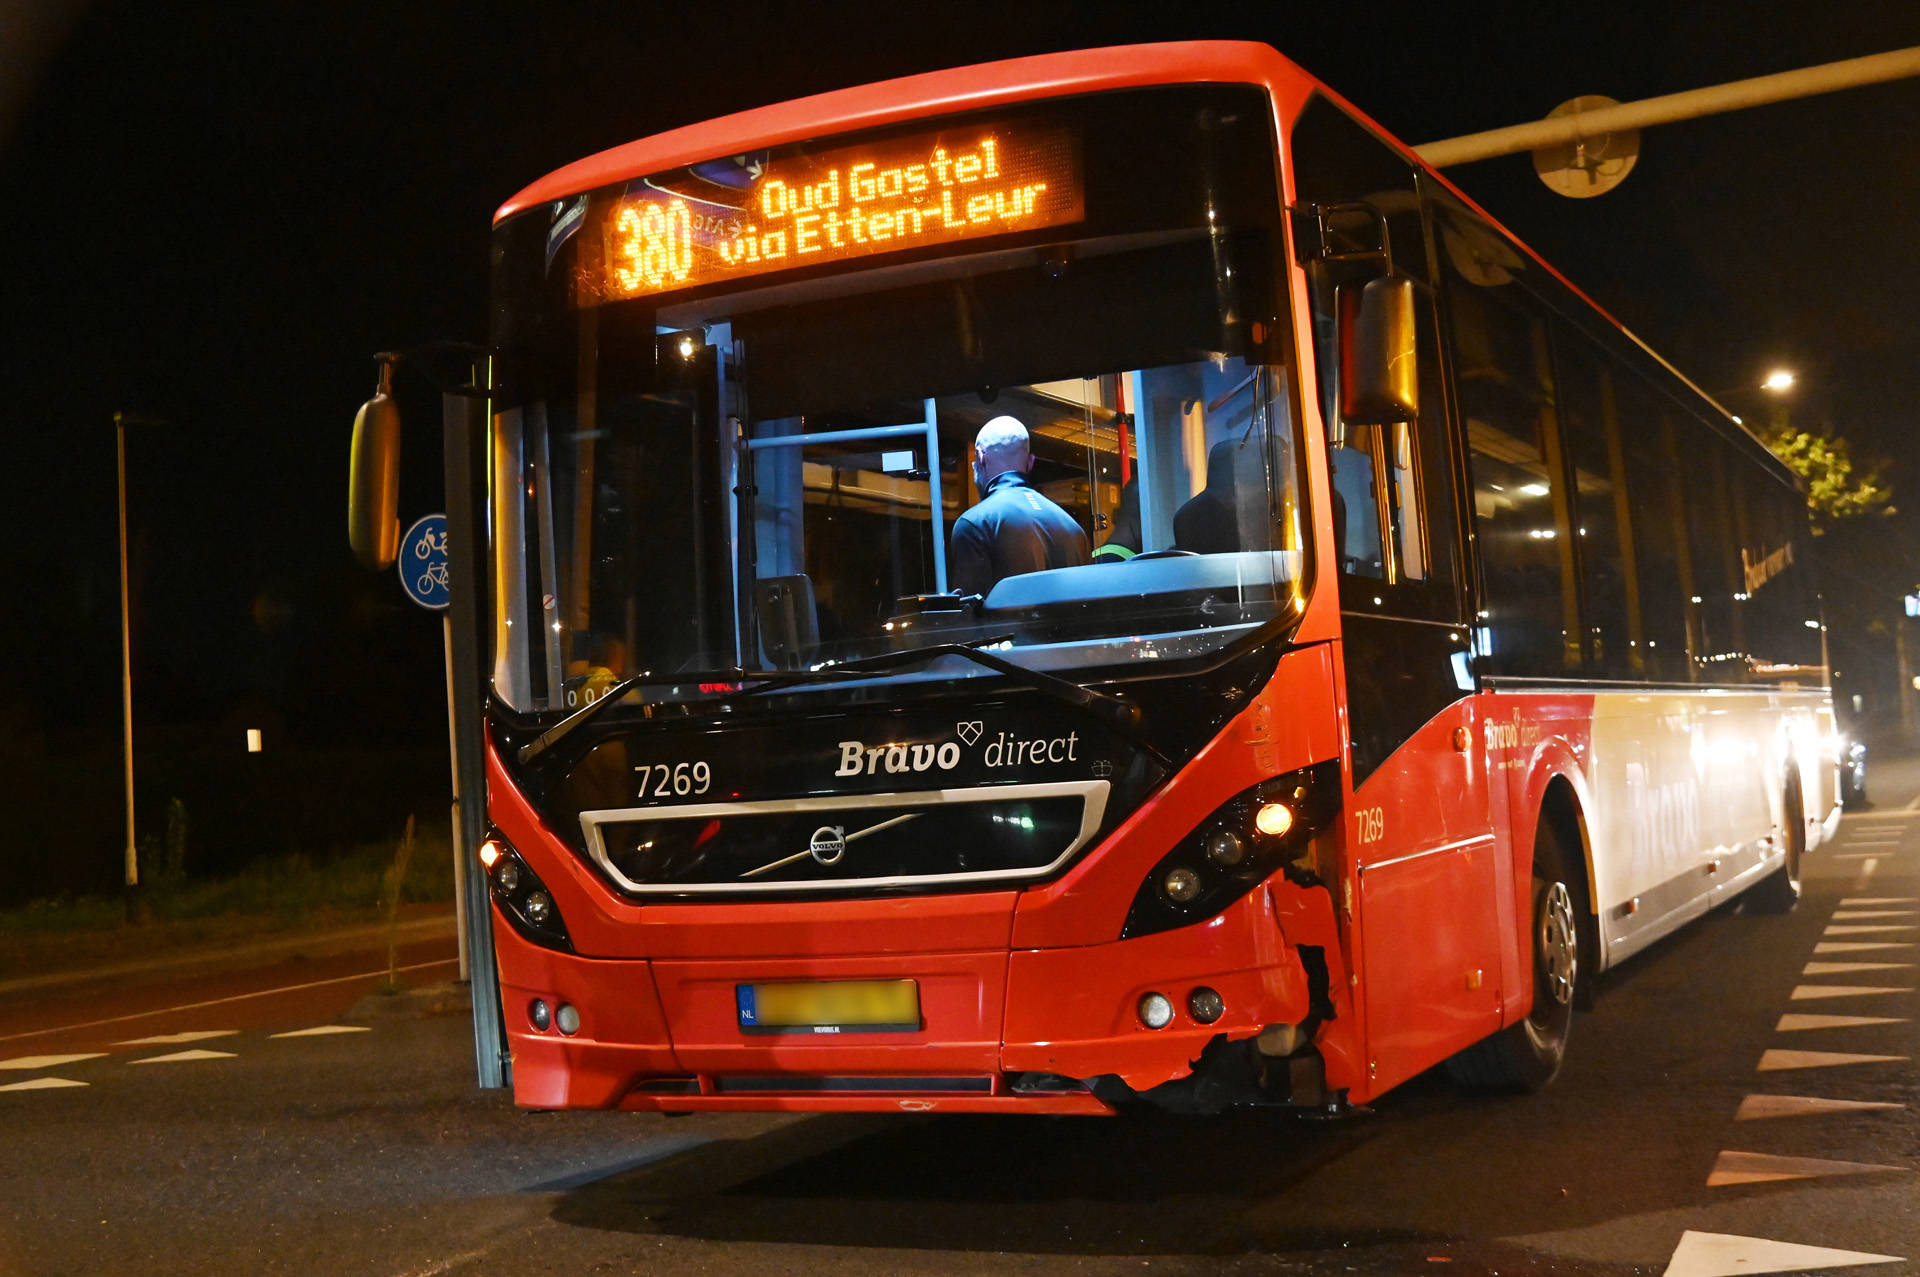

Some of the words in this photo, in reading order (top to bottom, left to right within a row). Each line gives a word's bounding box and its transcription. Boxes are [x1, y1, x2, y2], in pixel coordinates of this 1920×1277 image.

[763, 170, 839, 219] Oud
[850, 139, 999, 202] Gastel
[720, 225, 785, 265] via
[797, 184, 1046, 254] Etten-Leur
[618, 199, 691, 290] 380
[1484, 717, 1518, 750] Bravo
[834, 741, 961, 777] Bravo
[984, 731, 1079, 768] direct
[634, 761, 711, 798] 7269
[1355, 807, 1384, 845] 7269
[812, 842, 844, 850] VOLVO
[742, 1009, 754, 1019] NL
